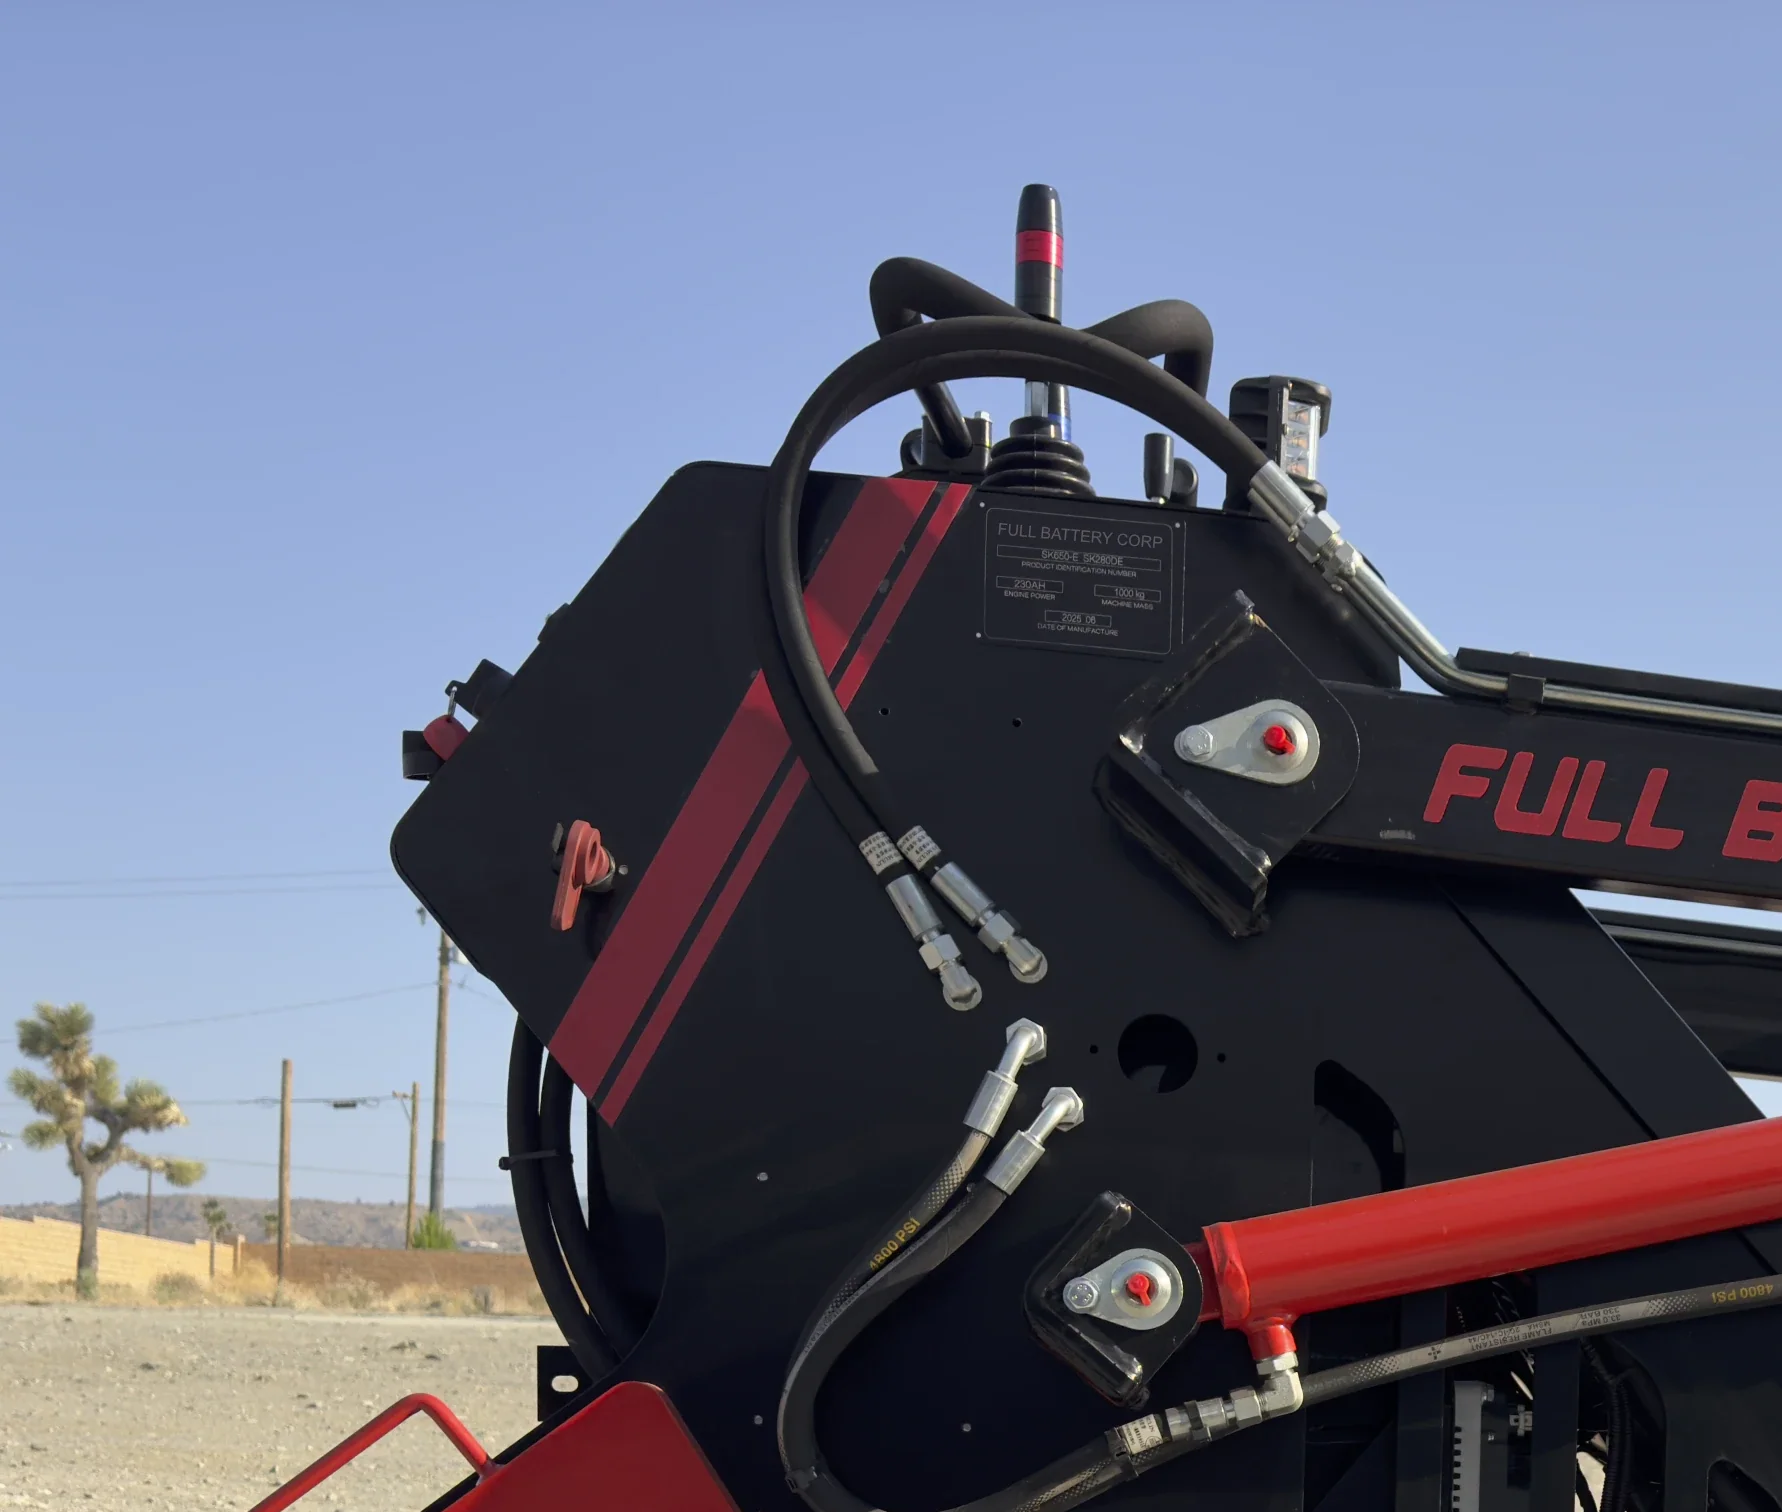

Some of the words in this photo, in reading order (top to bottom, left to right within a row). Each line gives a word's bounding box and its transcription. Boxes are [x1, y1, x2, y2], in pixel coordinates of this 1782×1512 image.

[997, 523, 1037, 538] FULL
[1040, 526, 1113, 544] BATTERY
[1117, 533, 1164, 548] CORP
[1041, 550, 1079, 562] SK650-E
[1021, 561, 1054, 570] PRODUCT
[1055, 563, 1106, 574] IDENTIFICATION
[1107, 568, 1137, 578] NUMBER
[1014, 579, 1046, 590] 230AH
[1004, 590, 1029, 599] ENGINE
[1030, 592, 1056, 600] POWER
[1114, 588, 1133, 598] 1000
[1134, 591, 1145, 600] kg
[1101, 599, 1133, 609] MACHINE
[1133, 602, 1154, 610] MASS
[1061, 613, 1082, 623] 2025
[1037, 622, 1055, 631] DATE
[1056, 624, 1066, 632] OF
[1067, 625, 1119, 636] MANUFACTURE
[1422, 744, 1684, 850] FULL
[869, 1240, 899, 1271] 4800
[895, 1217, 921, 1242] PSI
[1711, 1288, 1737, 1304] PSI
[1740, 1283, 1774, 1300] 4800
[1579, 1310, 1601, 1319] BAR
[1602, 1314, 1622, 1324] 33.0
[1527, 1320, 1551, 1330] MSHA
[1581, 1317, 1602, 1327] MPa
[1522, 1327, 1552, 1340] FLAME
[1470, 1334, 1520, 1351] RESISTANT
